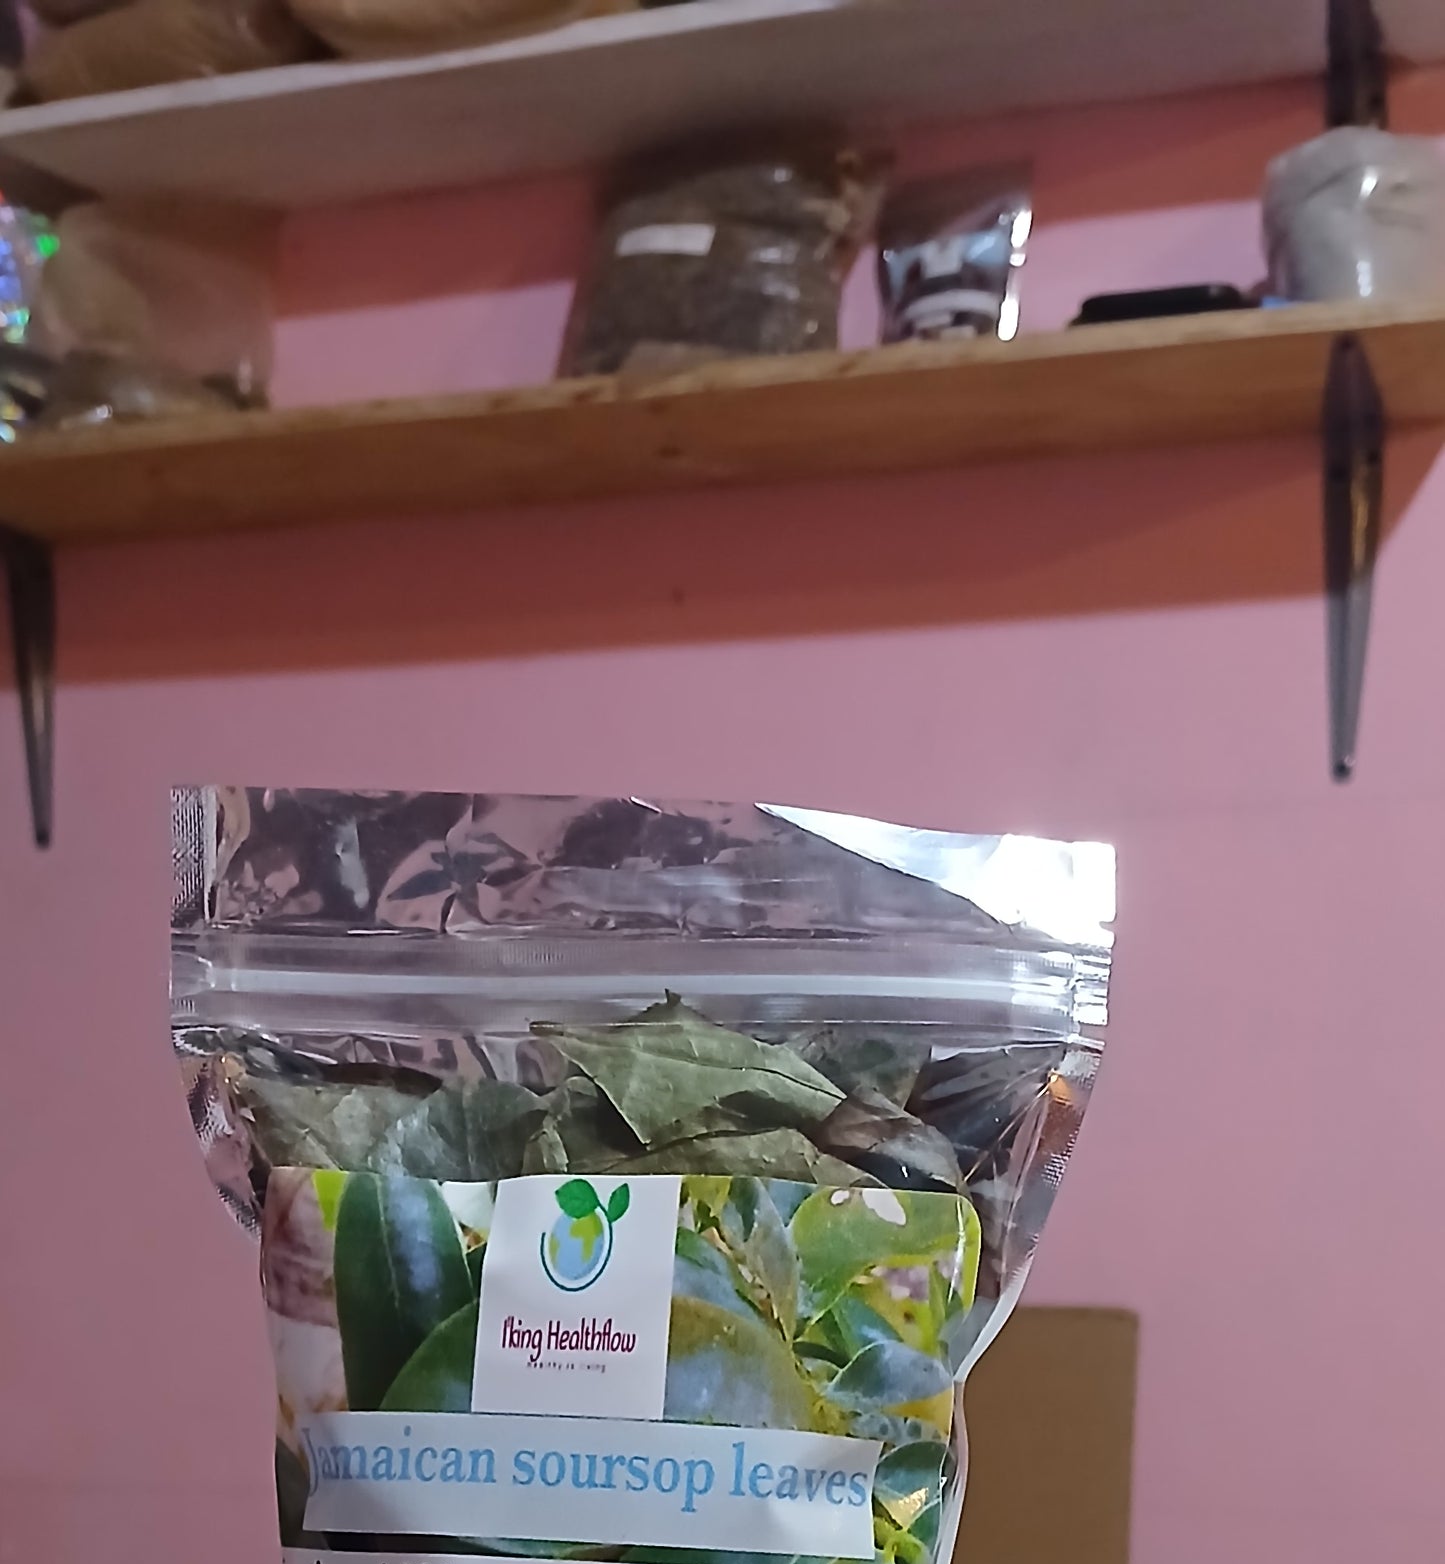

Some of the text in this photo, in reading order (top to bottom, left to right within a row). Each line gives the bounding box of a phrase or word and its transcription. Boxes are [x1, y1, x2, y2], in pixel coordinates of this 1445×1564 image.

[547, 1317, 637, 1353] Healthflow
[302, 1425, 868, 1512] Jamaican soursop leaves
